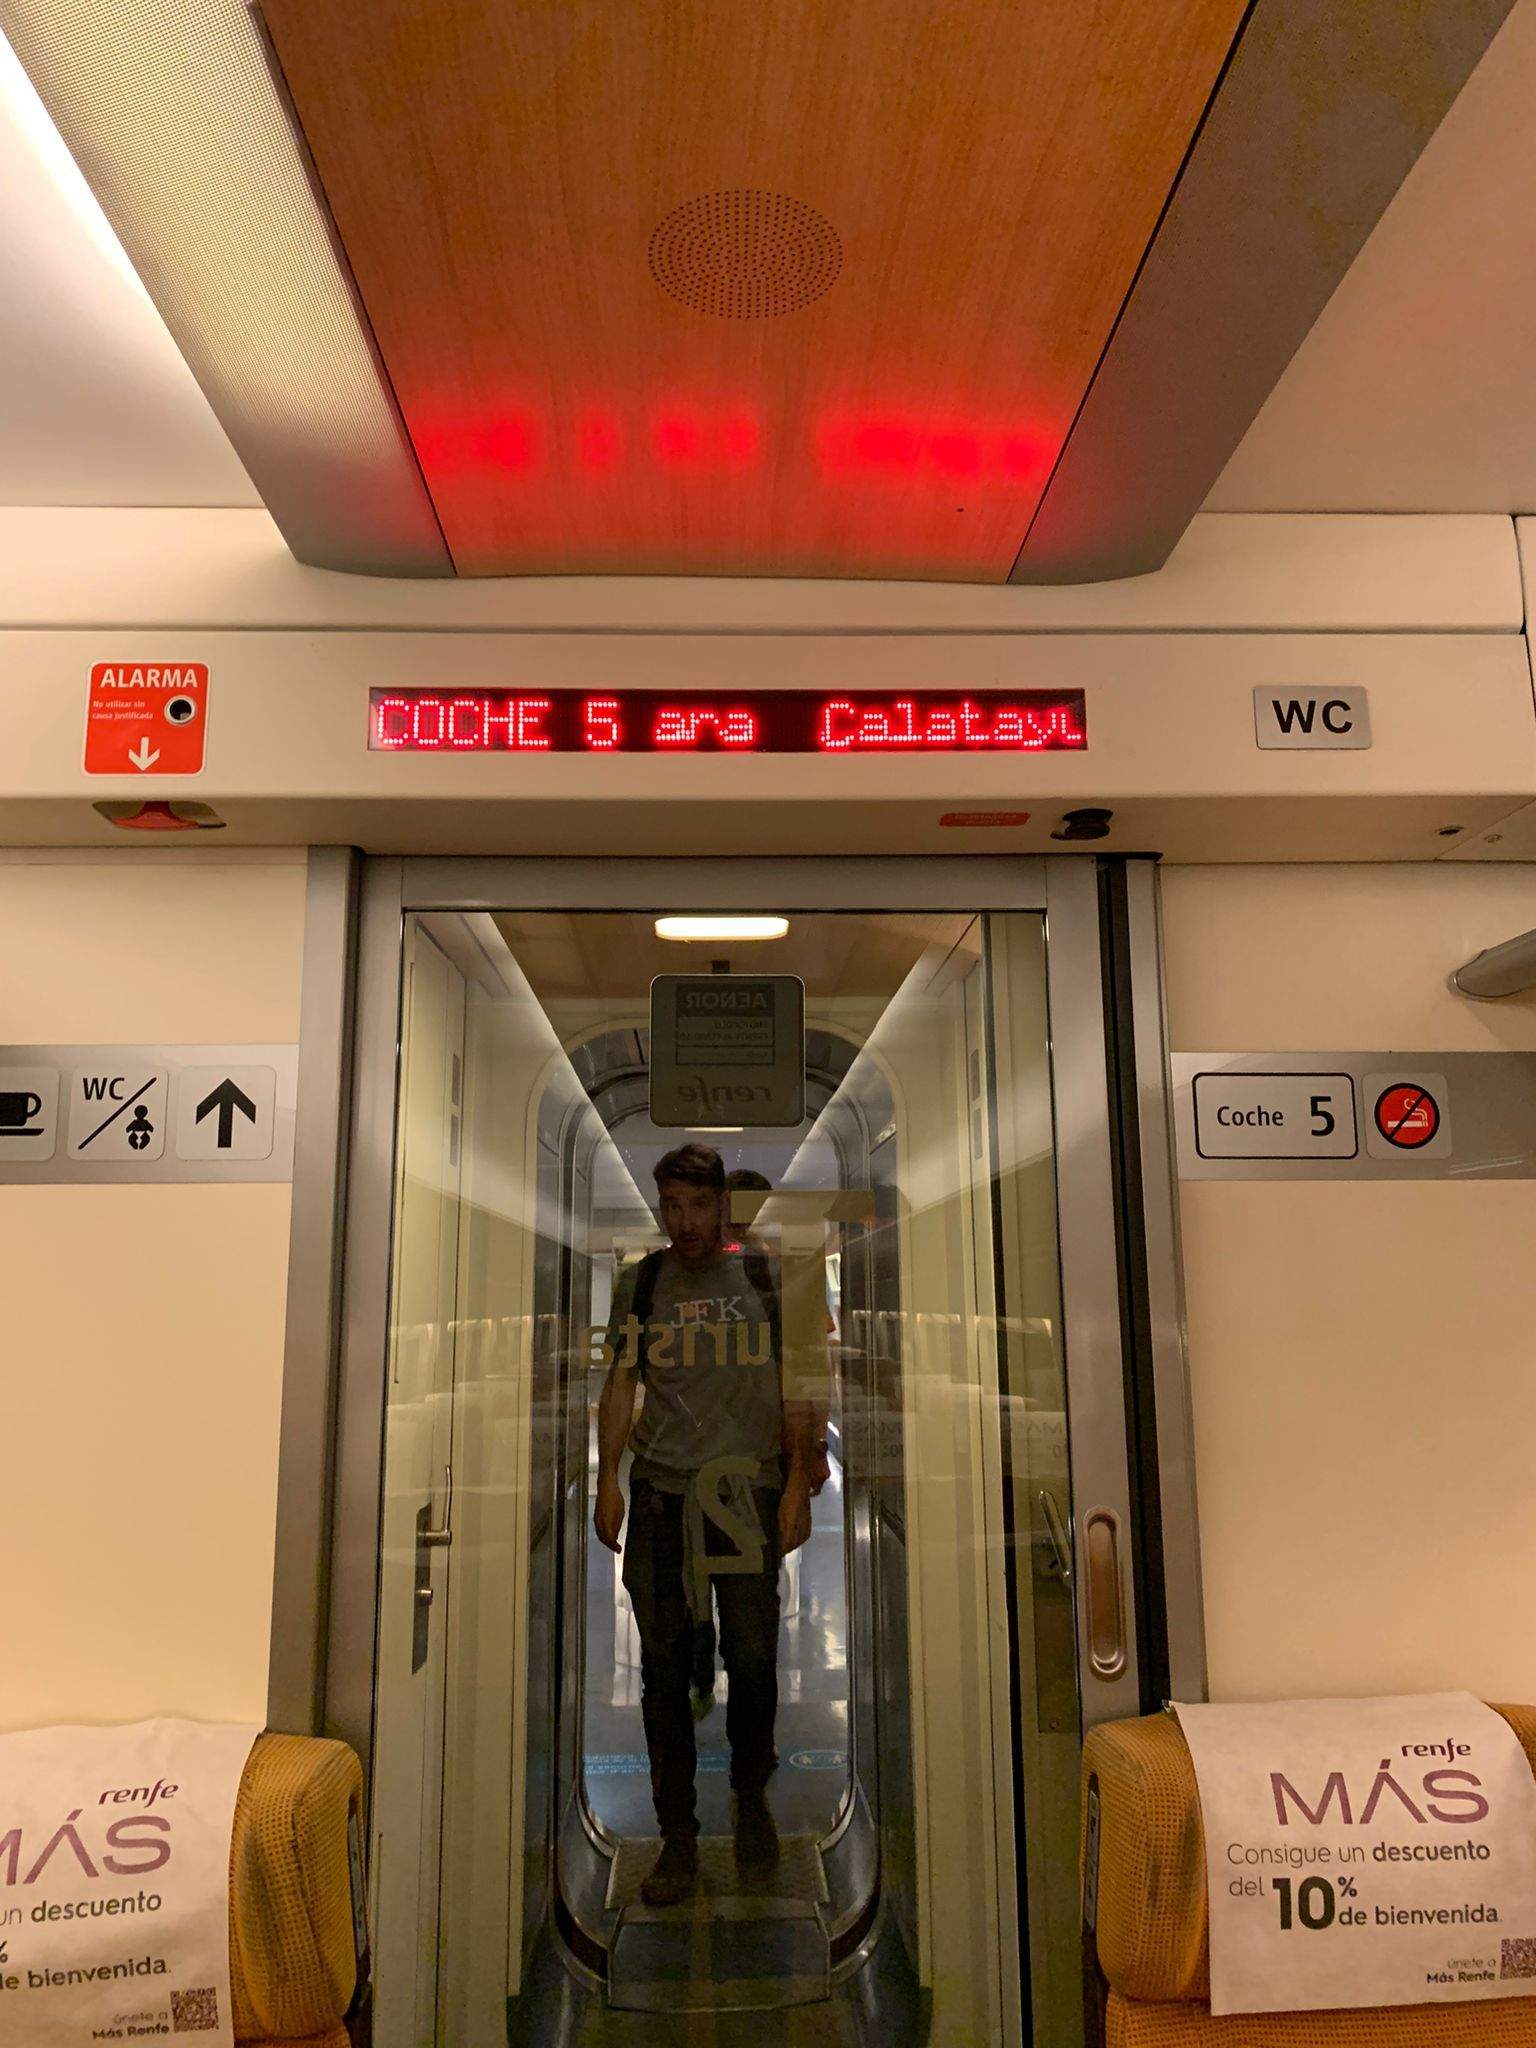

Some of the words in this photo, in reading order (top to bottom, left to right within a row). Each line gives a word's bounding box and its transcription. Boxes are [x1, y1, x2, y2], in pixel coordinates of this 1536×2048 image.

[100, 668, 198, 688] ALARMA
[93, 700, 104, 708] No
[1271, 699, 1353, 734] WC
[378, 699, 550, 746] COCHE
[586, 701, 619, 747] 5
[655, 711, 754, 743] ara
[82, 1077, 125, 1101] WC
[1216, 1105, 1284, 1126] Coche
[1310, 1095, 1336, 1137] 5
[670, 1296, 746, 1329] JFK
[1401, 1738, 1472, 1763] renfe
[98, 1778, 179, 1808] renfe
[1270, 1758, 1489, 1826] MÁS
[0, 1809, 171, 1887] ÁS
[1227, 1843, 1331, 1869] Consigue
[1339, 1845, 1365, 1864] un
[1372, 1840, 1491, 1863] descuento
[1229, 1876, 1265, 1897] del
[31, 1890, 162, 1923] descuento
[1338, 1906, 1368, 1926] de
[1375, 1904, 1503, 1926] bienvenida.
[27, 1956, 172, 1989] bienvenida.
[1458, 1970, 1496, 1983] Renfe
[127, 2024, 170, 2037] Renfe
